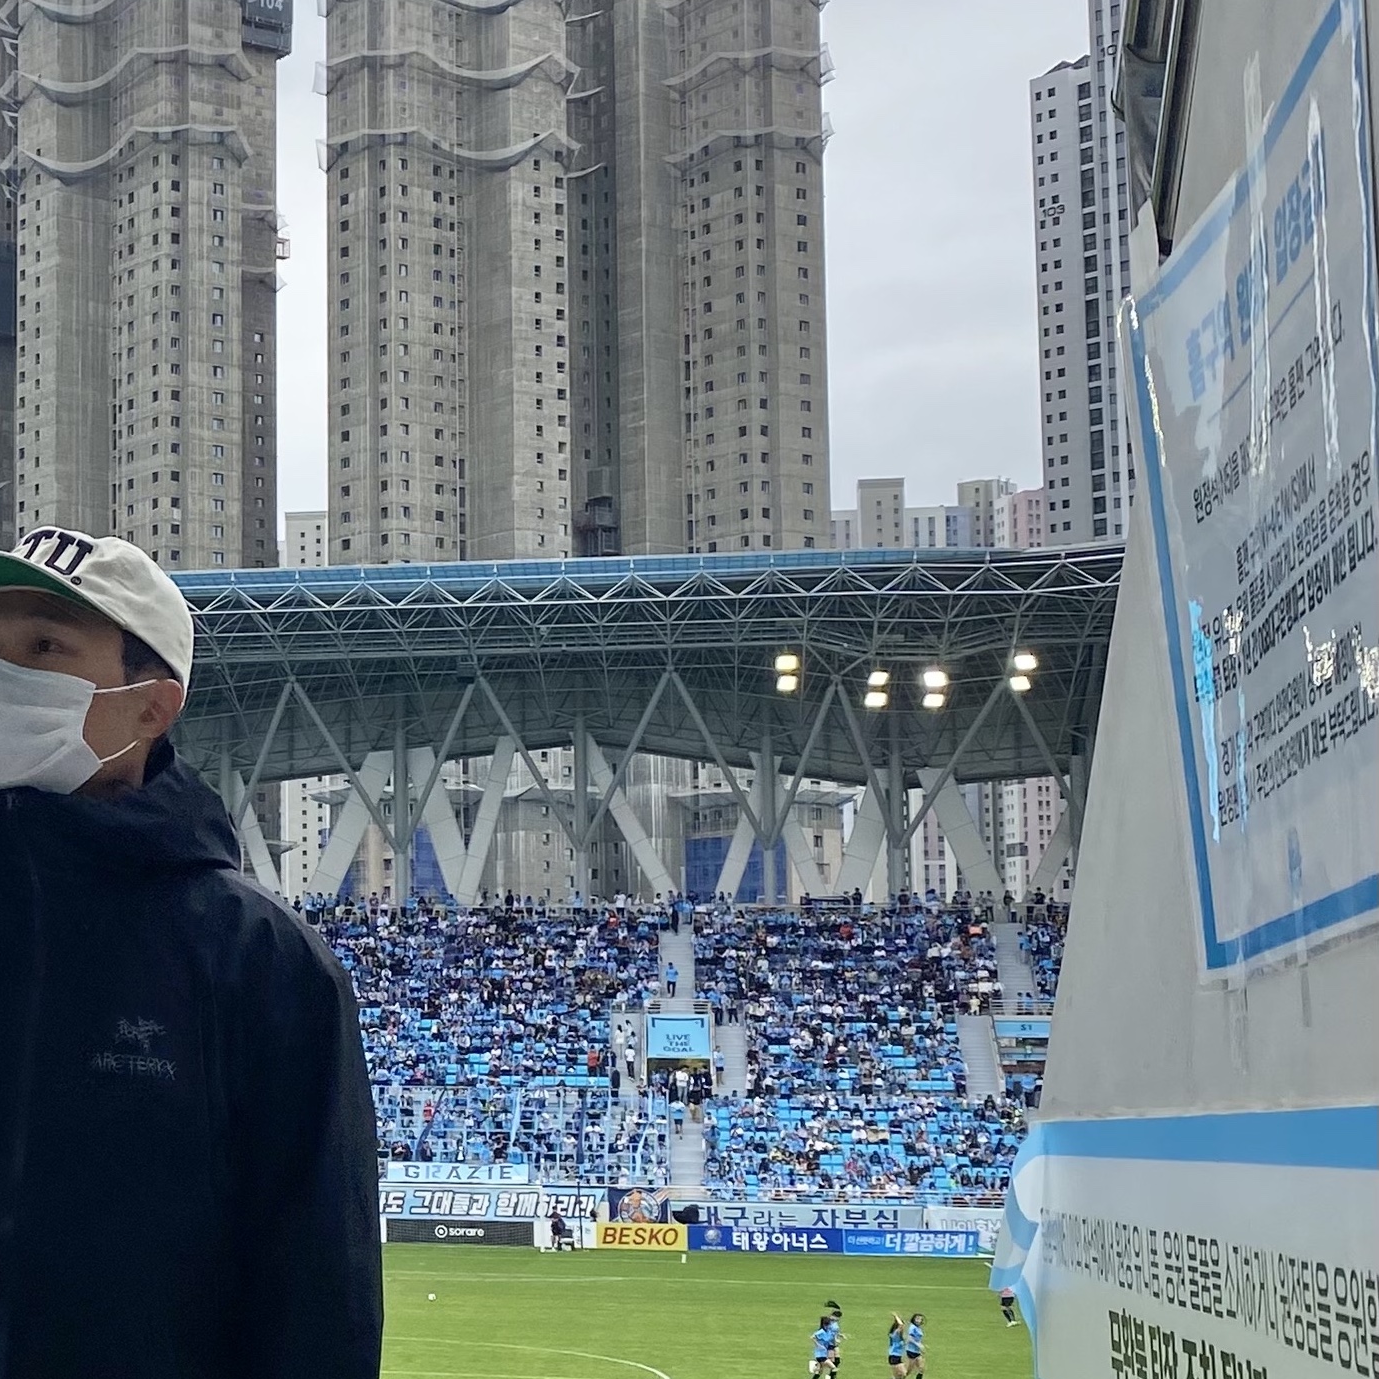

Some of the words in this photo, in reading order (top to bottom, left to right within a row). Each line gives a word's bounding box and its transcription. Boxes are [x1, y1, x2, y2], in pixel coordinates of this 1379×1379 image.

[1041, 203, 1065, 217] 103
[1352, 442, 1370, 511] 경우
[1347, 498, 1377, 574] 됩니다.
[23, 530, 94, 575] TU
[666, 1033, 691, 1041] LIVE
[403, 1164, 514, 1180] GRAZIE
[412, 1190, 490, 1217] 그대들과
[495, 1191, 596, 1218] 함께하리라
[698, 1204, 798, 1228] 대구라는
[811, 1208, 900, 1230] 자부심
[448, 1225, 485, 1237] sorare
[602, 1226, 679, 1246] BESKO
[731, 1229, 829, 1252] 태왕아너스
[885, 1232, 902, 1252] 더
[903, 1232, 974, 1253] 깔끔하게!
[1186, 1234, 1222, 1319] 물품을
[1279, 1252, 1333, 1362] 원정팀을
